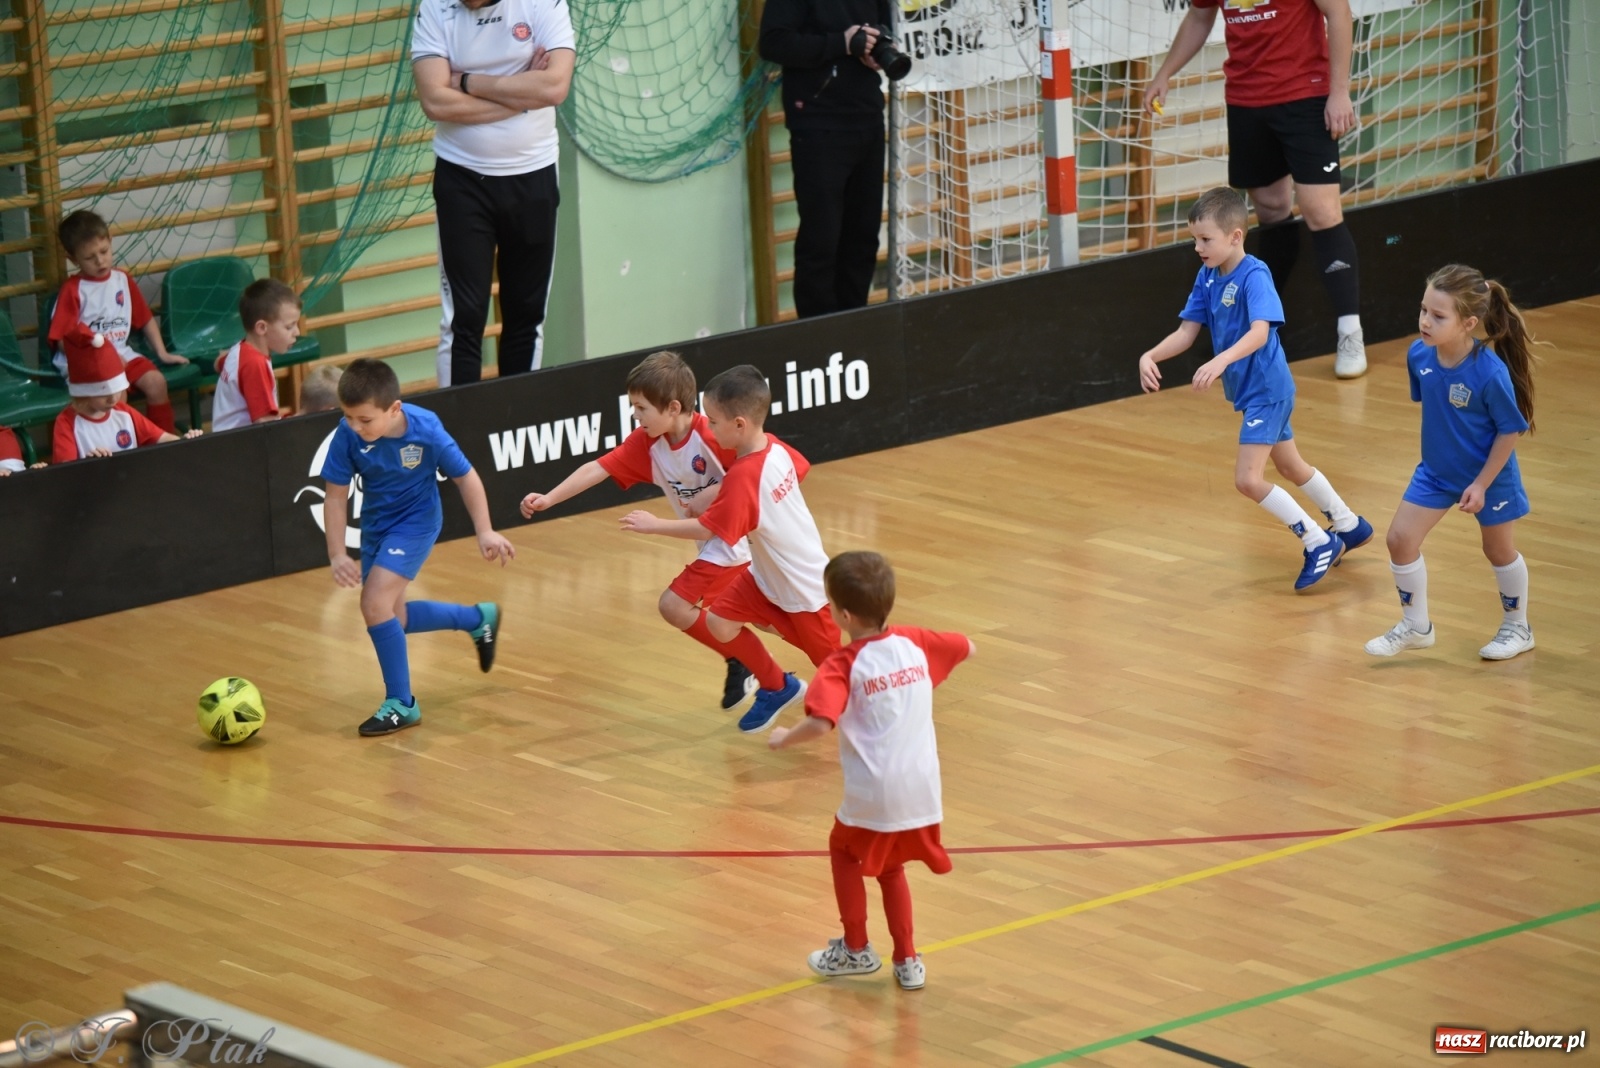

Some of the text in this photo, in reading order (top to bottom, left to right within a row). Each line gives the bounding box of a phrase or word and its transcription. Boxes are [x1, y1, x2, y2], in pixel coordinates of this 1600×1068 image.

[1227, 10, 1278, 25] CHEVROLET
[488, 352, 871, 472] www.h.info
[863, 665, 926, 696] UKS CIESZYN
